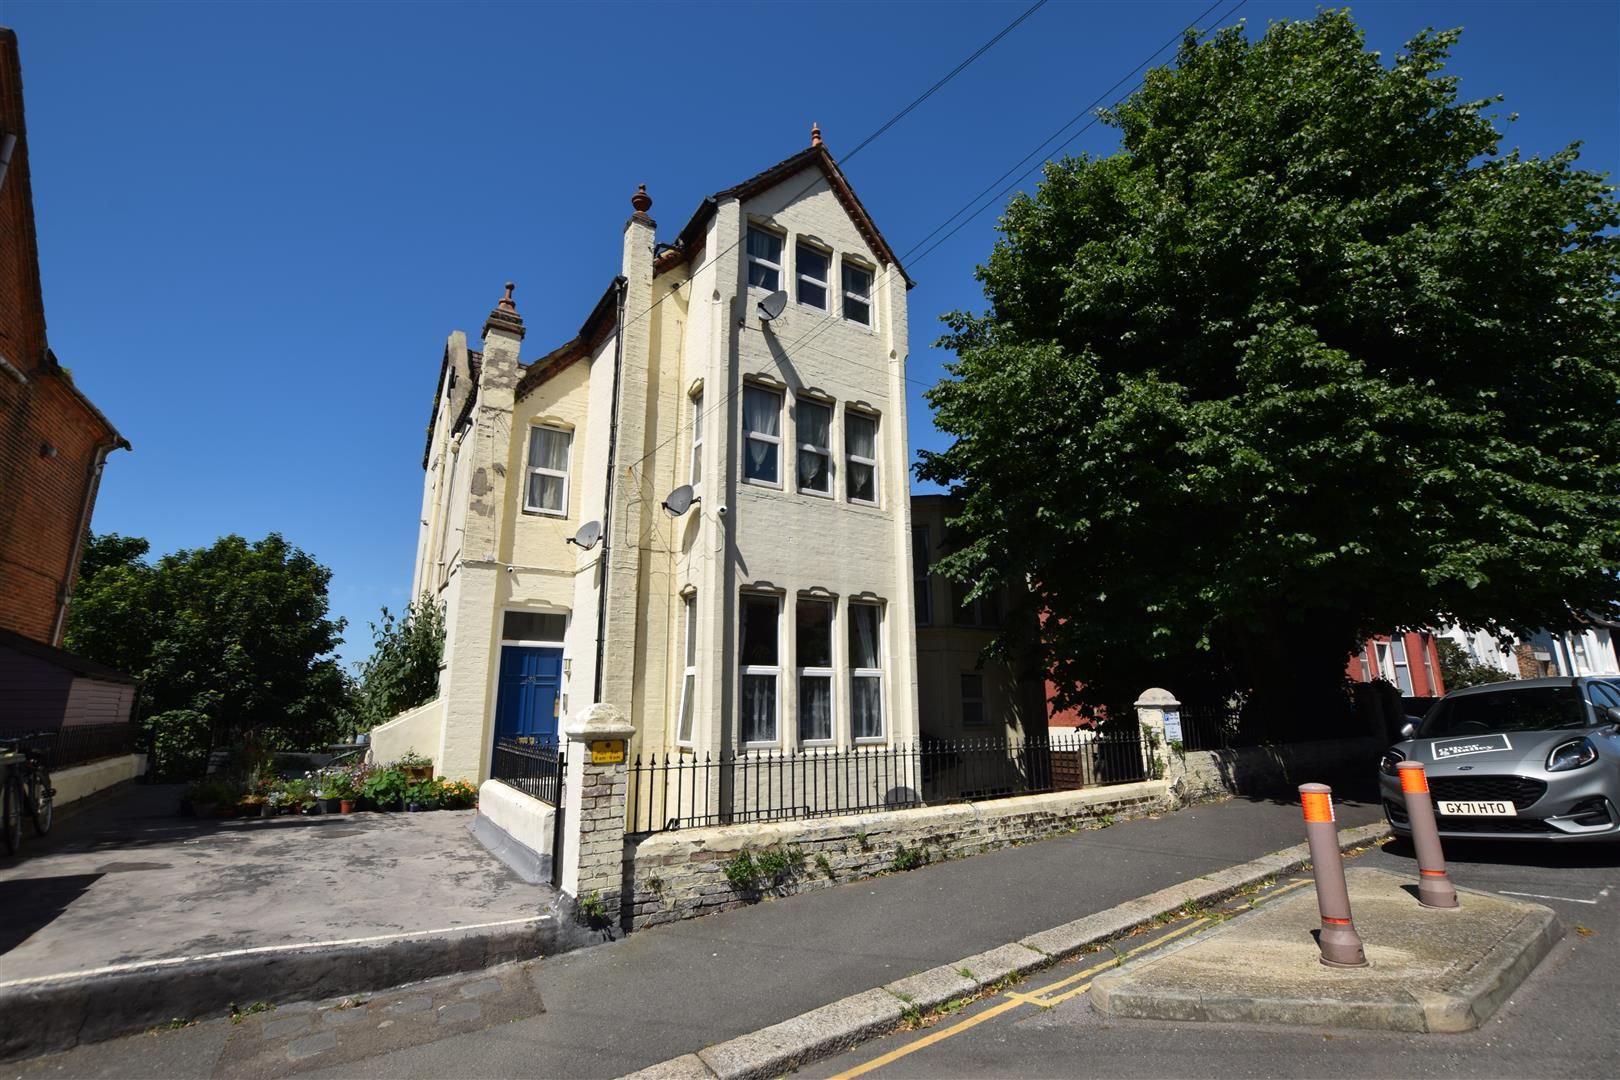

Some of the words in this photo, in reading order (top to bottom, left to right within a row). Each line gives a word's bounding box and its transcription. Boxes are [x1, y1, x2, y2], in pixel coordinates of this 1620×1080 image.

[1438, 744, 1479, 753] Oliver
[1453, 745, 1494, 754] Bailey
[1446, 803, 1476, 814] GX71
[1478, 803, 1506, 814] HTO
